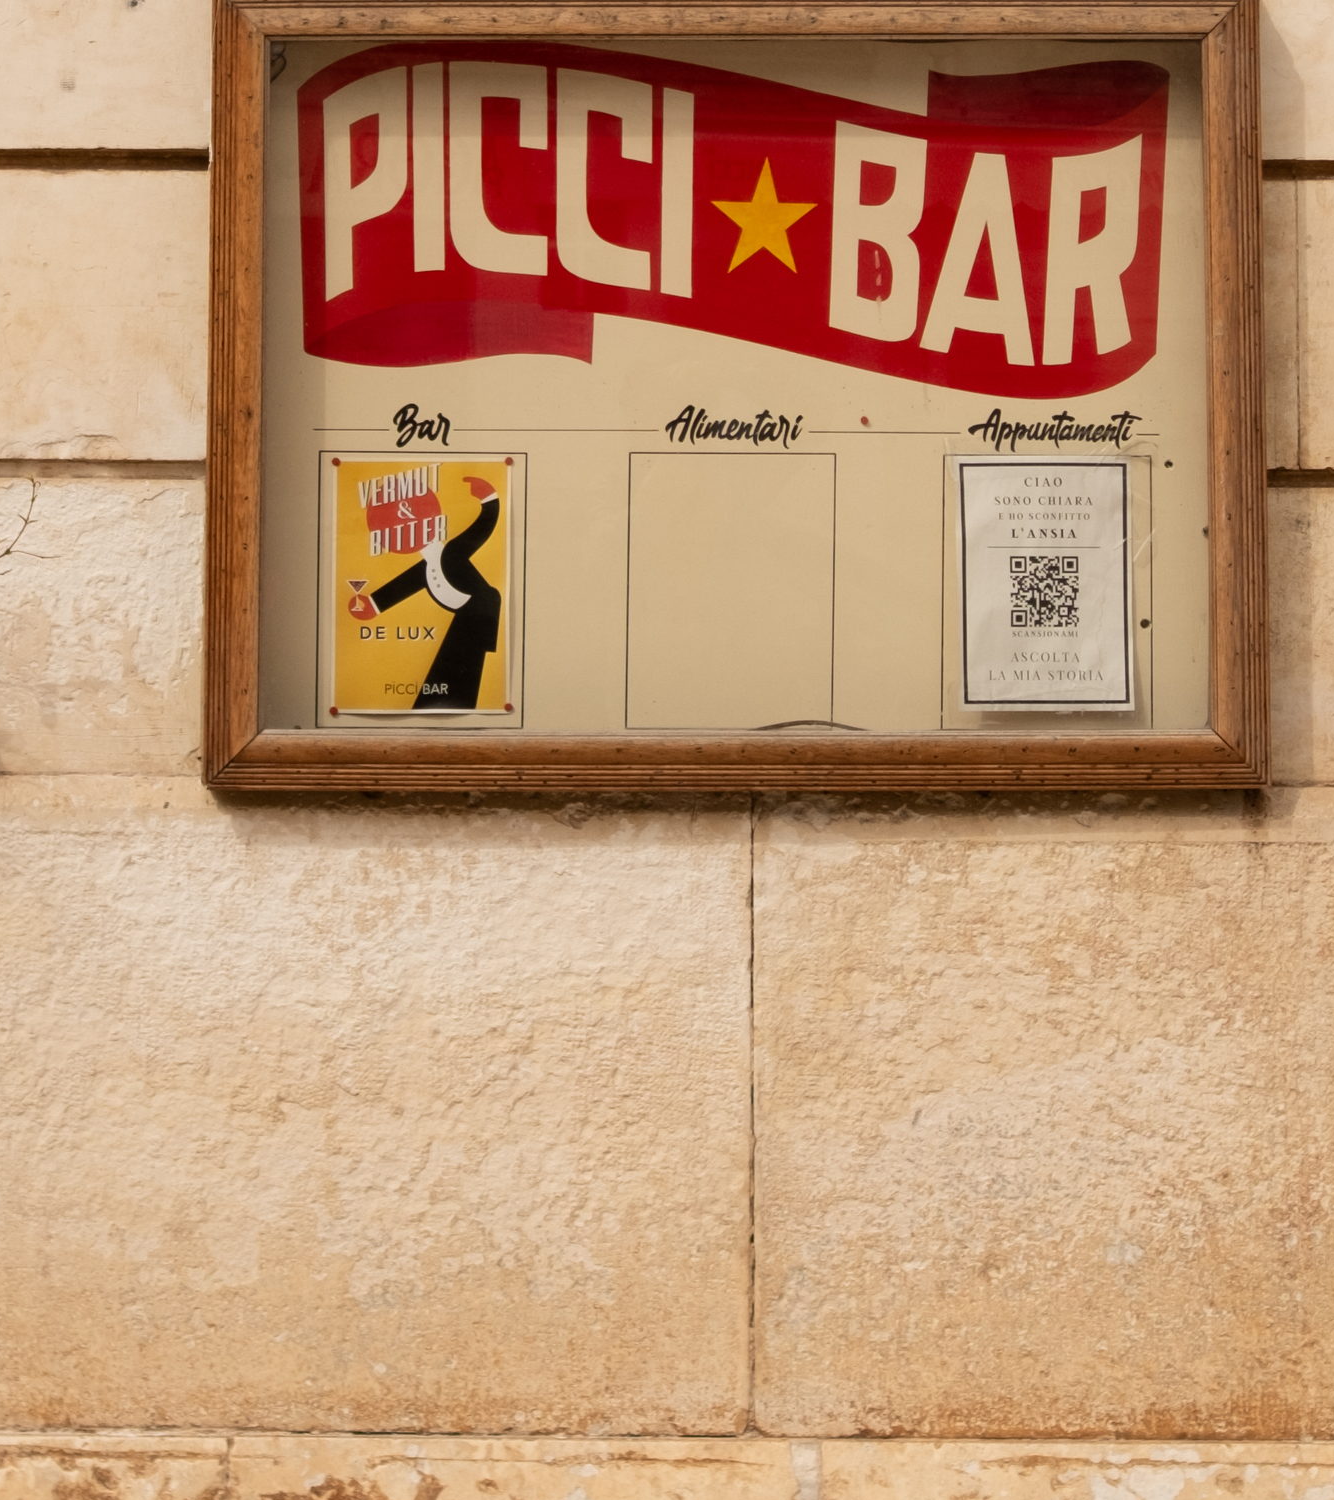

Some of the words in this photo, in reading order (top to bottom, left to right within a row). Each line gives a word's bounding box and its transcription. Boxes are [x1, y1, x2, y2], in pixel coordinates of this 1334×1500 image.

[323, 61, 695, 302] PICCI
[828, 119, 1143, 368] BAR
[392, 403, 451, 448] Bar
[665, 405, 803, 450] Alimentari
[968, 408, 1143, 451] Appuntamenti
[358, 463, 441, 509] VERMUT
[1024, 477, 1063, 488] CIAO
[994, 496, 1032, 506] SONO
[1038, 496, 1093, 506] CHIARA
[397, 500, 416, 519] &
[998, 512, 1004, 521] E
[1009, 512, 1024, 521] HO
[1028, 512, 1091, 521] SCONFITTO
[370, 514, 447, 557] BITTER
[1011, 528, 1077, 539] L'ANSIA
[360, 626, 386, 640] DE
[396, 626, 436, 640] LUX
[1011, 652, 1080, 663] ASCOLTA
[989, 670, 1006, 681] LA
[1013, 670, 1041, 681] MIA
[1048, 670, 1104, 681] STORIA
[422, 683, 449, 695] BAR
